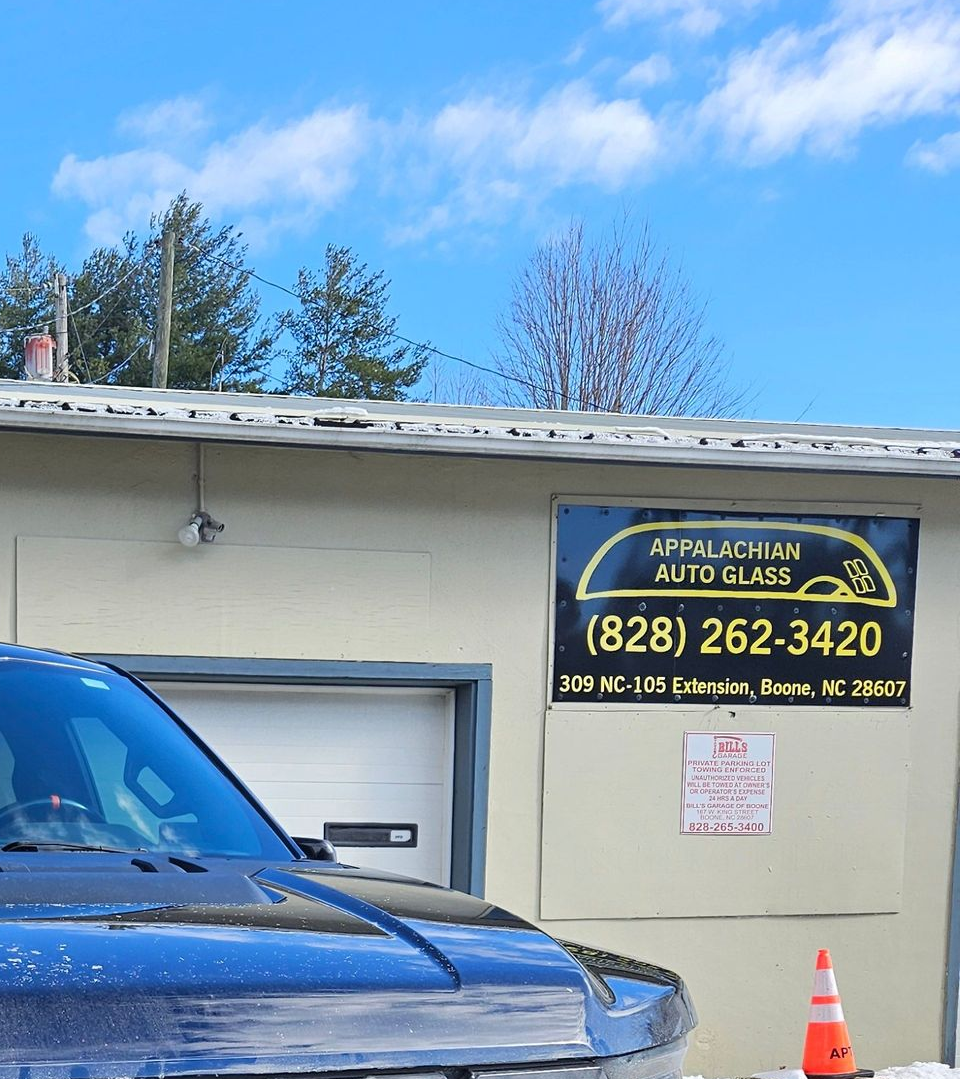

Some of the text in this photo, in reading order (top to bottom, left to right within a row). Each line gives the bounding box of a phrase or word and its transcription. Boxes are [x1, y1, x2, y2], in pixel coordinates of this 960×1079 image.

[650, 538, 801, 560] APPALACHIAN
[655, 564, 791, 585] AUTO GLASS
[587, 615, 882, 657] (828) 262-3420
[559, 675, 906, 698] 309 NC-105 Extension, Boone, NC 28607
[688, 822, 764, 832] 828-265-3400
